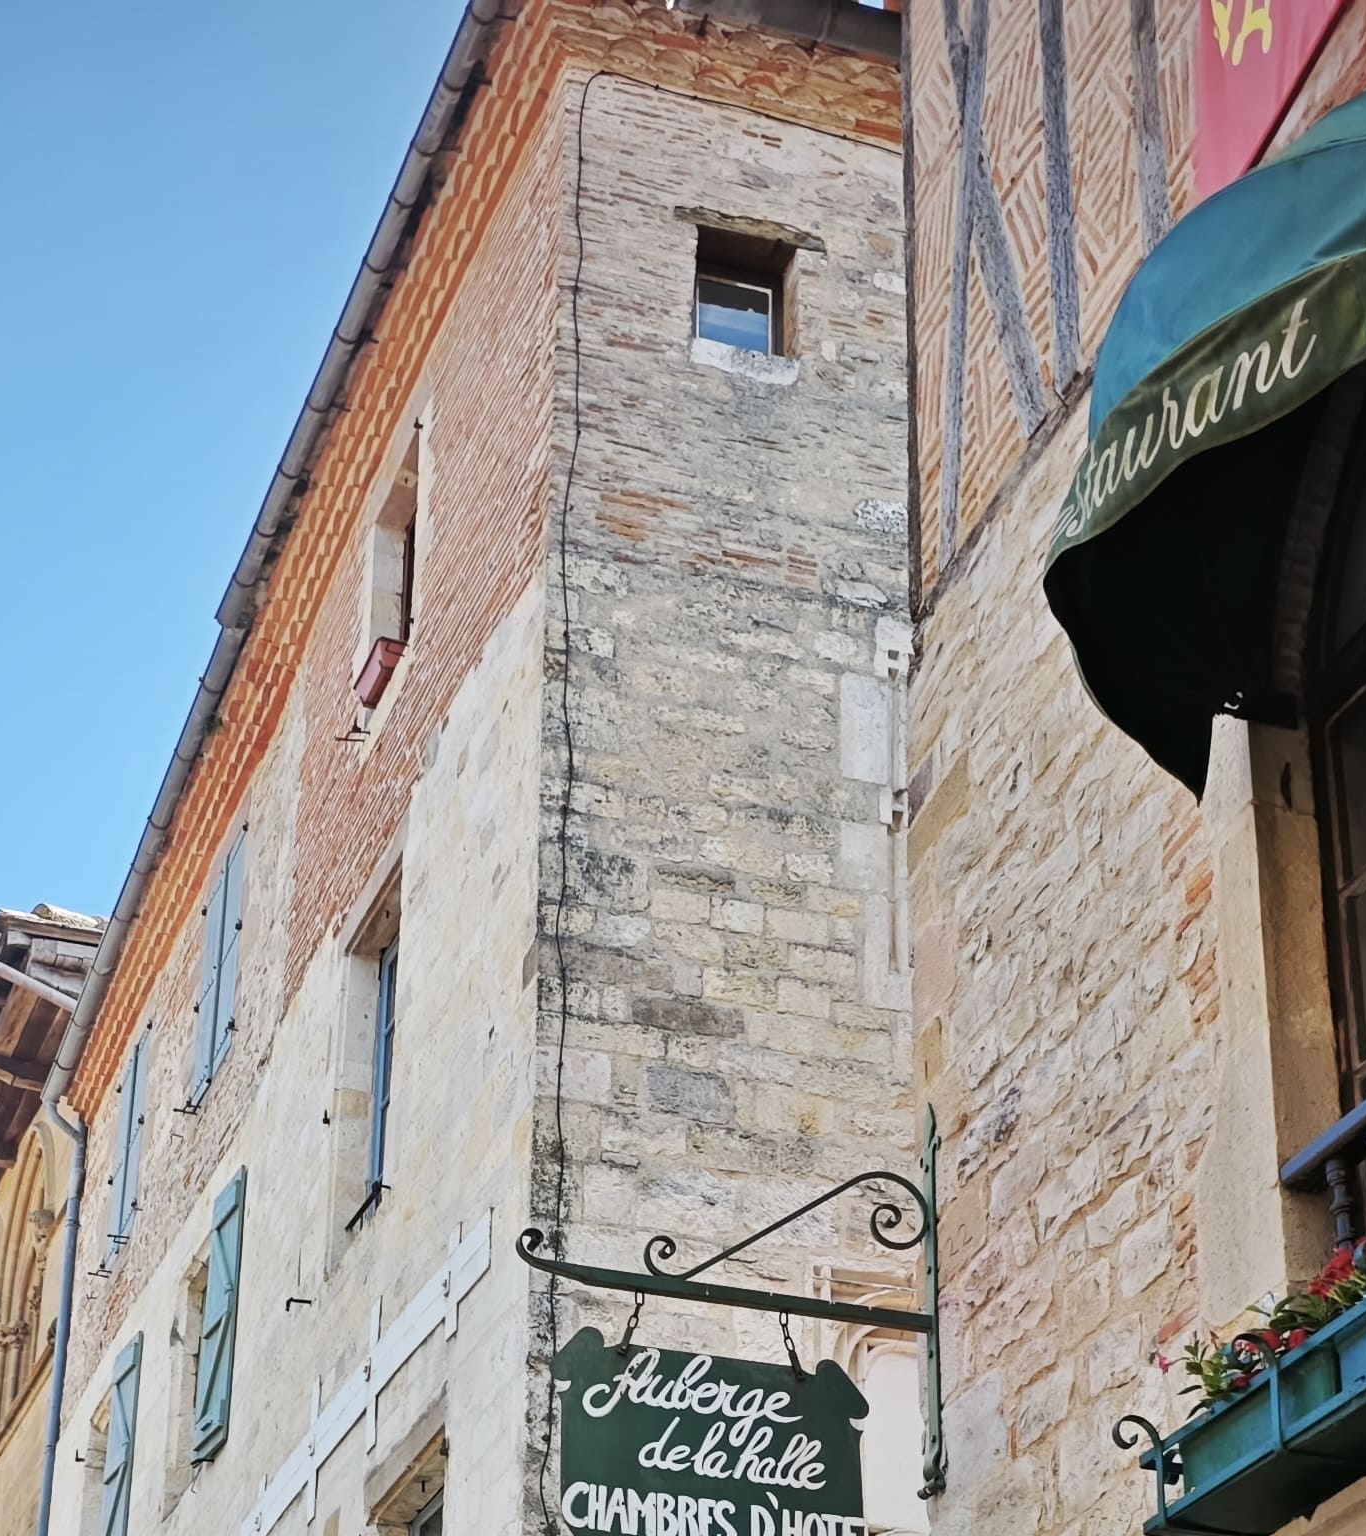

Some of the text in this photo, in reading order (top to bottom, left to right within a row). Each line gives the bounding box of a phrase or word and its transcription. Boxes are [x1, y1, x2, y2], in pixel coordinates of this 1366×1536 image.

[1048, 298, 1318, 552] estaurant
[582, 1347, 803, 1447] Auberge
[732, 1427, 826, 1490] halle
